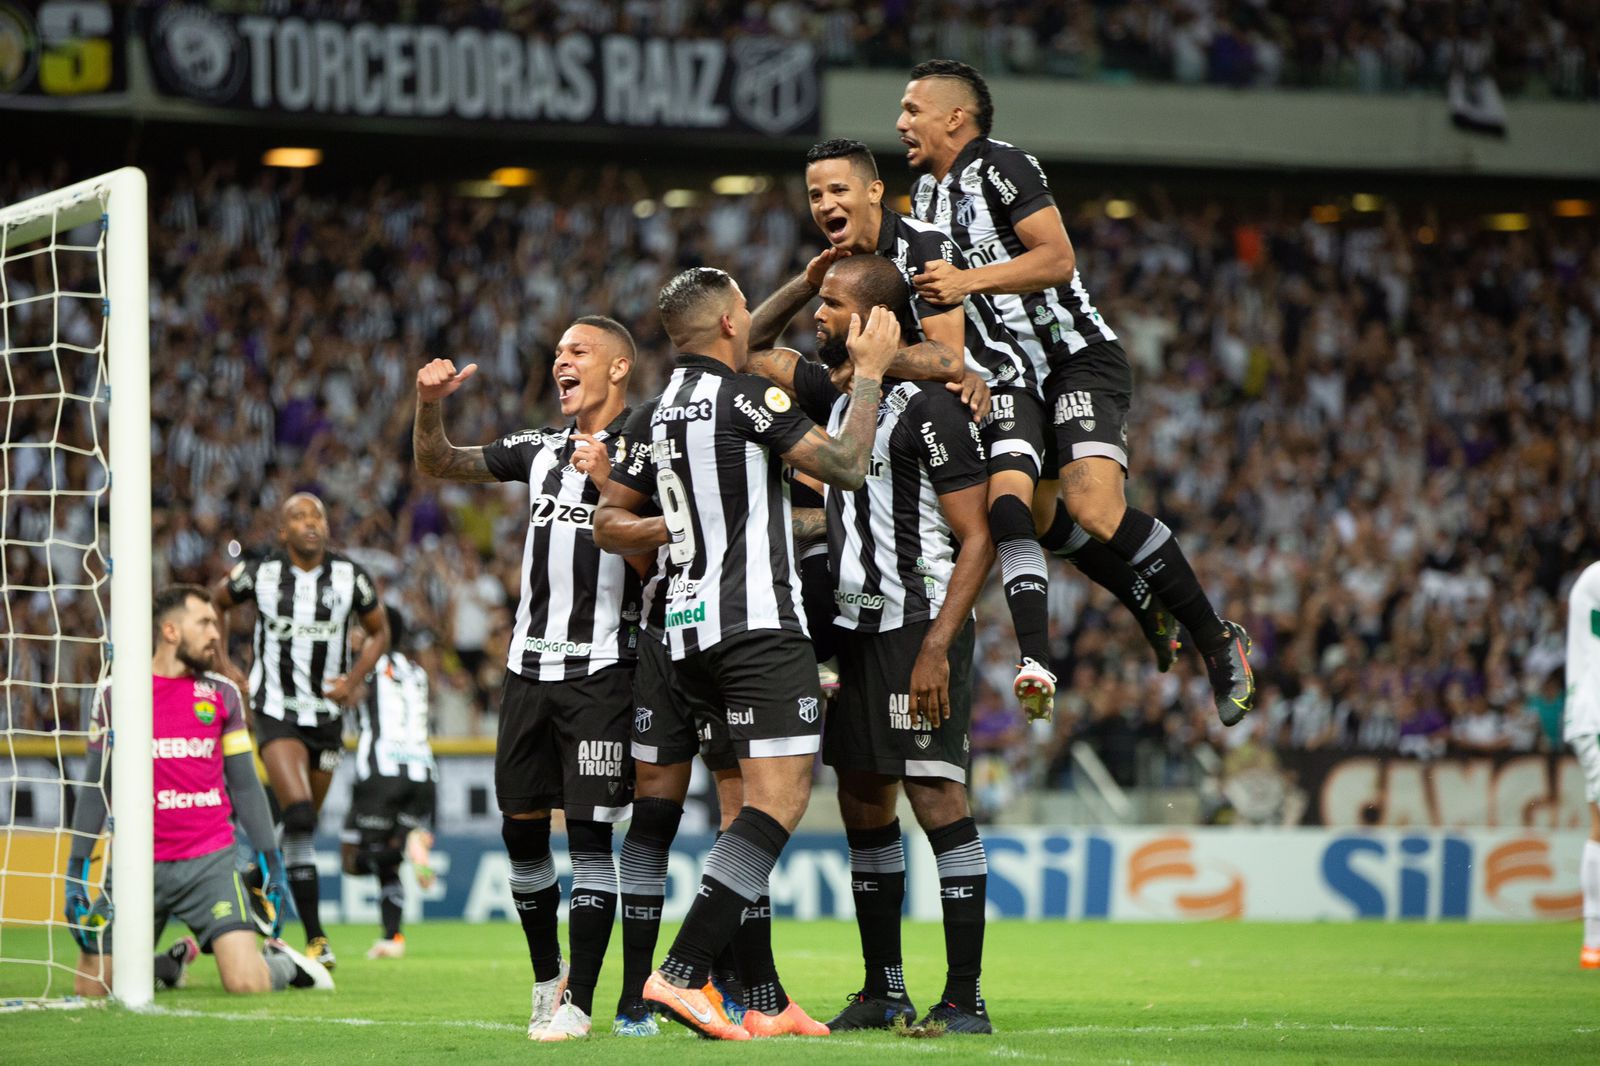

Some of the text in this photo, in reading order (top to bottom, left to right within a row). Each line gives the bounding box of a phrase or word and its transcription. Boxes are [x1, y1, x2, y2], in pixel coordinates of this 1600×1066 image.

[238, 15, 730, 126] TORCEDORAS RAIZ
[655, 400, 710, 424] sanet
[740, 400, 771, 433] bmg
[511, 433, 542, 446] bmg
[923, 431, 945, 468] bmg
[656, 467, 694, 566] 9
[578, 740, 623, 762] AUTO
[578, 760, 622, 777] TRUCK
[157, 788, 222, 810] Sicredi
[1320, 836, 1475, 920] Sil
[570, 894, 605, 910] CSC
[625, 905, 662, 921] CSC
